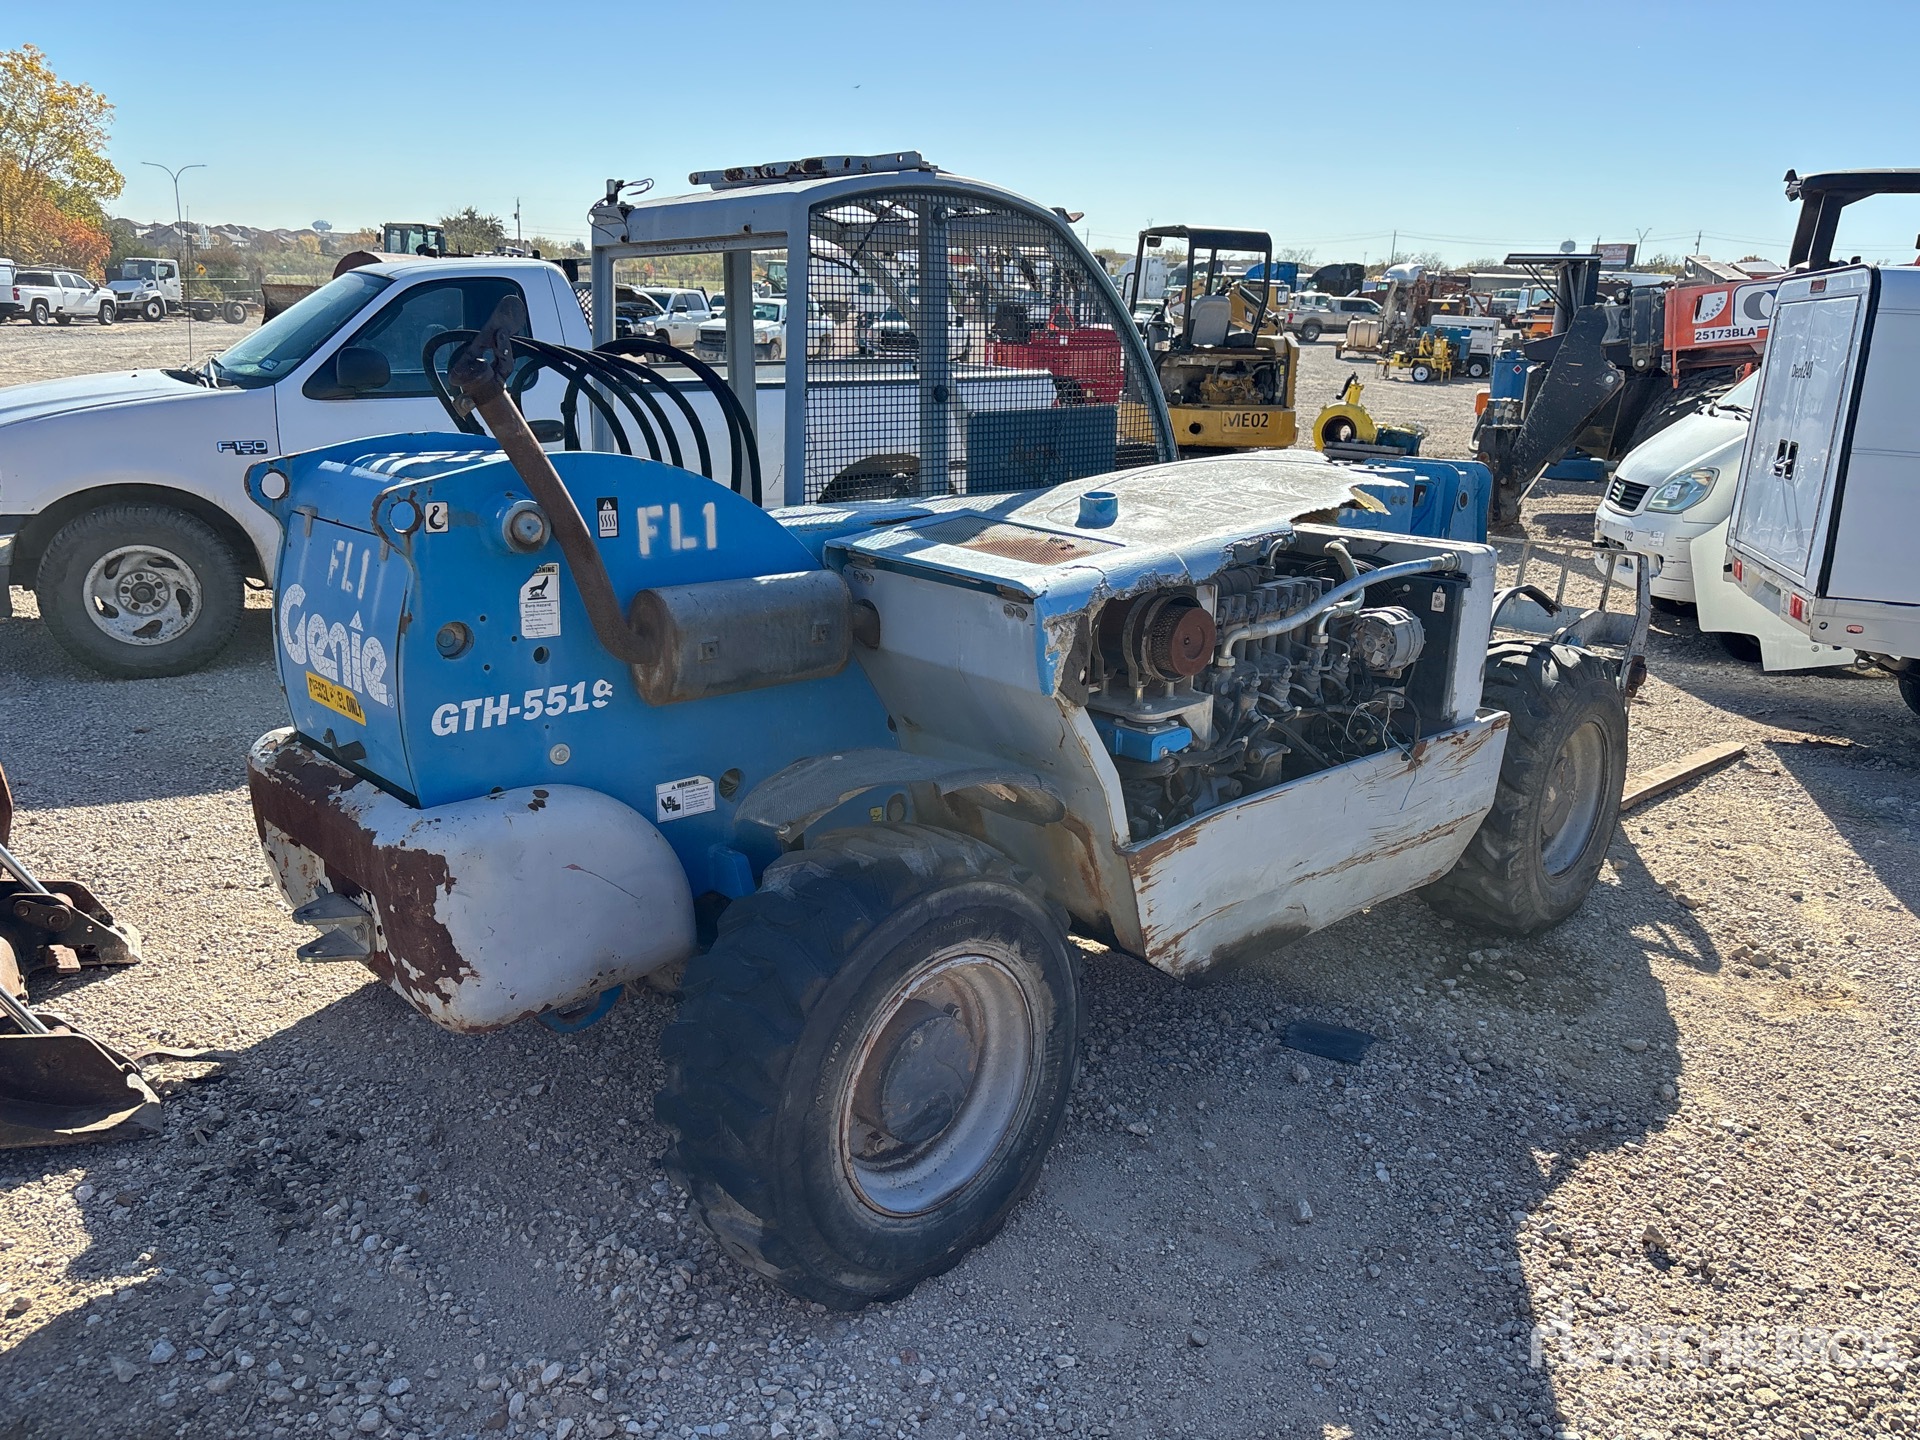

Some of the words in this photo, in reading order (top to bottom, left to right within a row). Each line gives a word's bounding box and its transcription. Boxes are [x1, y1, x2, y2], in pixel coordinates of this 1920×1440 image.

[1695, 327, 1756, 341] 25173BLA
[637, 502, 717, 556] FL1
[1624, 530, 1634, 542] 122
[280, 583, 389, 706] Genie
[431, 679, 613, 737] GTH-5519
[676, 778, 700, 789] WARNING
